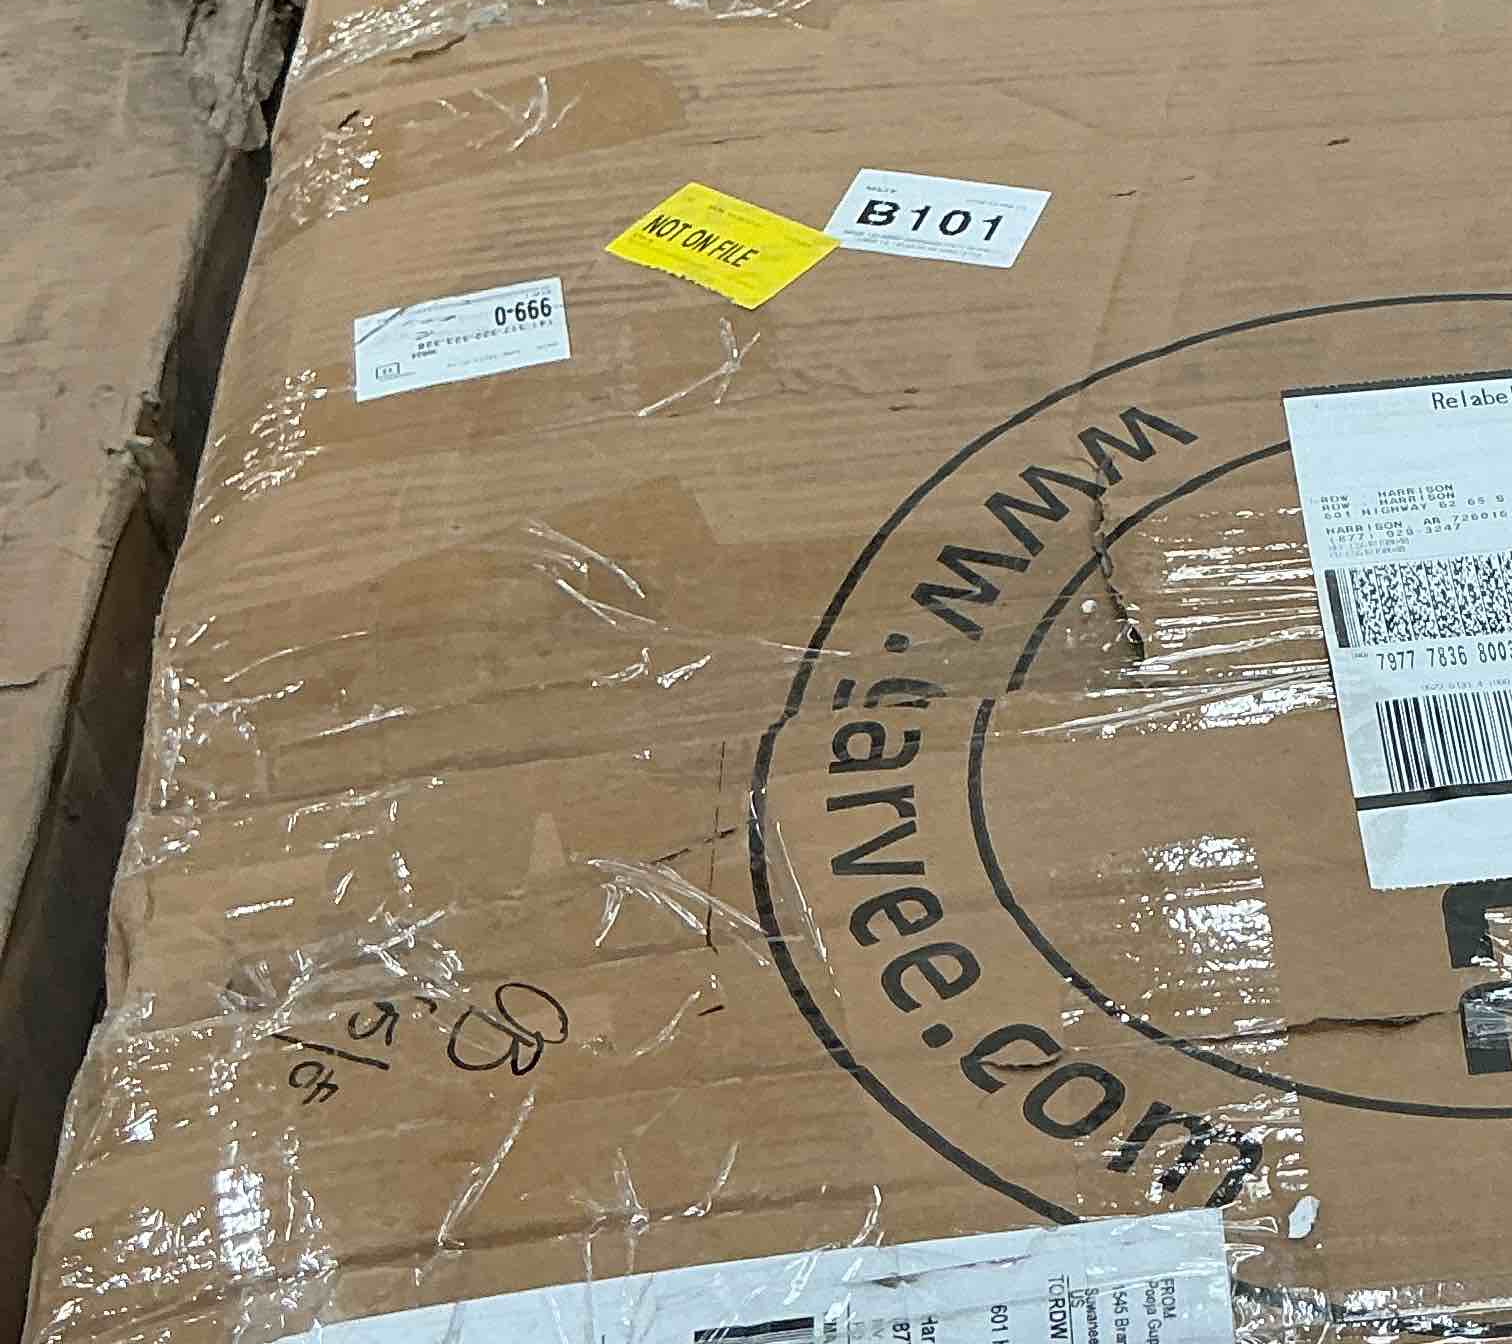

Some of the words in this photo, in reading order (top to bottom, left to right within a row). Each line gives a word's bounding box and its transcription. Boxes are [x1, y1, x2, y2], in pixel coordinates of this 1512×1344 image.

[856, 199, 1003, 241] B101
[643, 213, 692, 243] NOT
[682, 229, 715, 249] ON
[710, 237, 760, 268] FILE
[1377, 484, 1454, 498] HARRISON
[1379, 492, 1455, 506] HARRISON
[1361, 503, 1428, 517] HIGHWAY
[1423, 516, 1441, 526] AR
[1375, 649, 1416, 671] 7977
[1426, 645, 1468, 668] 7836
[1048, 1272, 1065, 1297] TO
[1069, 1288, 1087, 1309] US
[1143, 1281, 1160, 1316] Pooja
[1159, 1278, 1177, 1319] FROM
[990, 1304, 1009, 1333] 601
[1048, 1296, 1069, 1340] RDW
